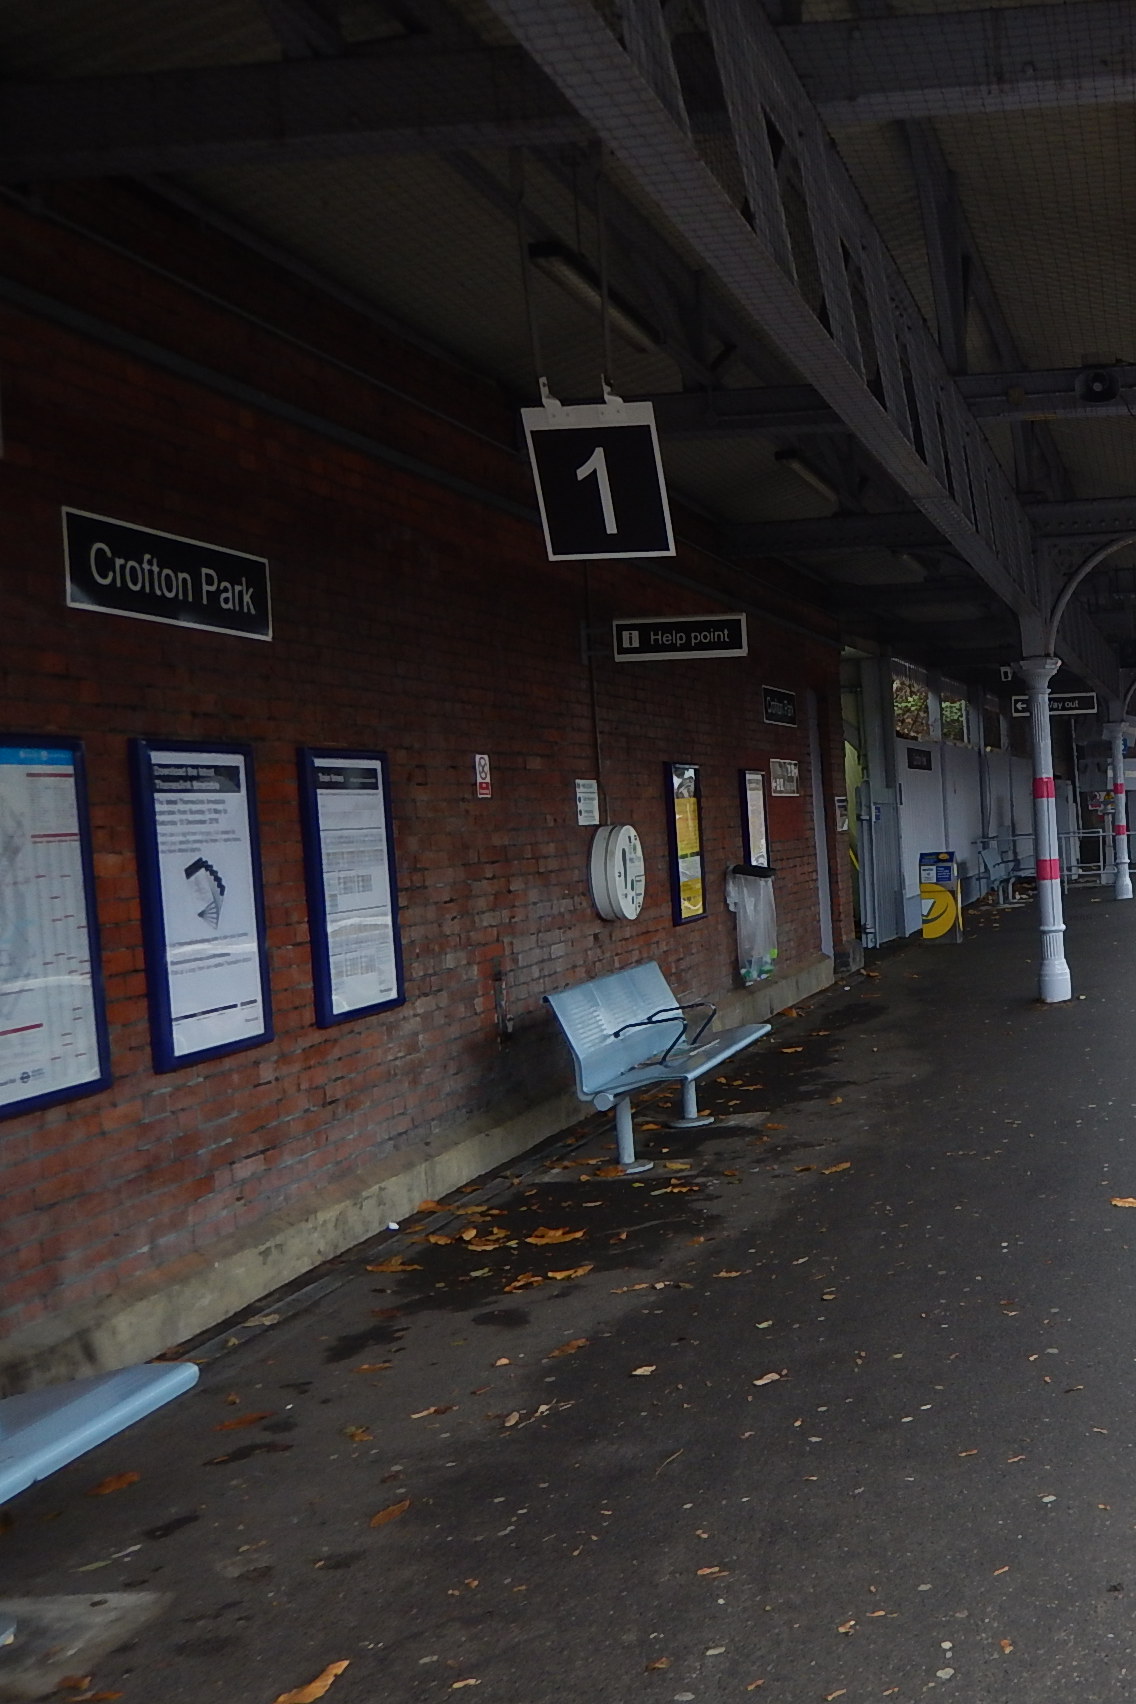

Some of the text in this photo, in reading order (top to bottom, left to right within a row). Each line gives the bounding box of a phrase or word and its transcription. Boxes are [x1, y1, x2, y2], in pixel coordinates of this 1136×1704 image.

[576, 446, 618, 534] 1
[89, 541, 256, 615] Crofton Park
[650, 628, 730, 647] Help point
[1064, 700, 1079, 708] out
